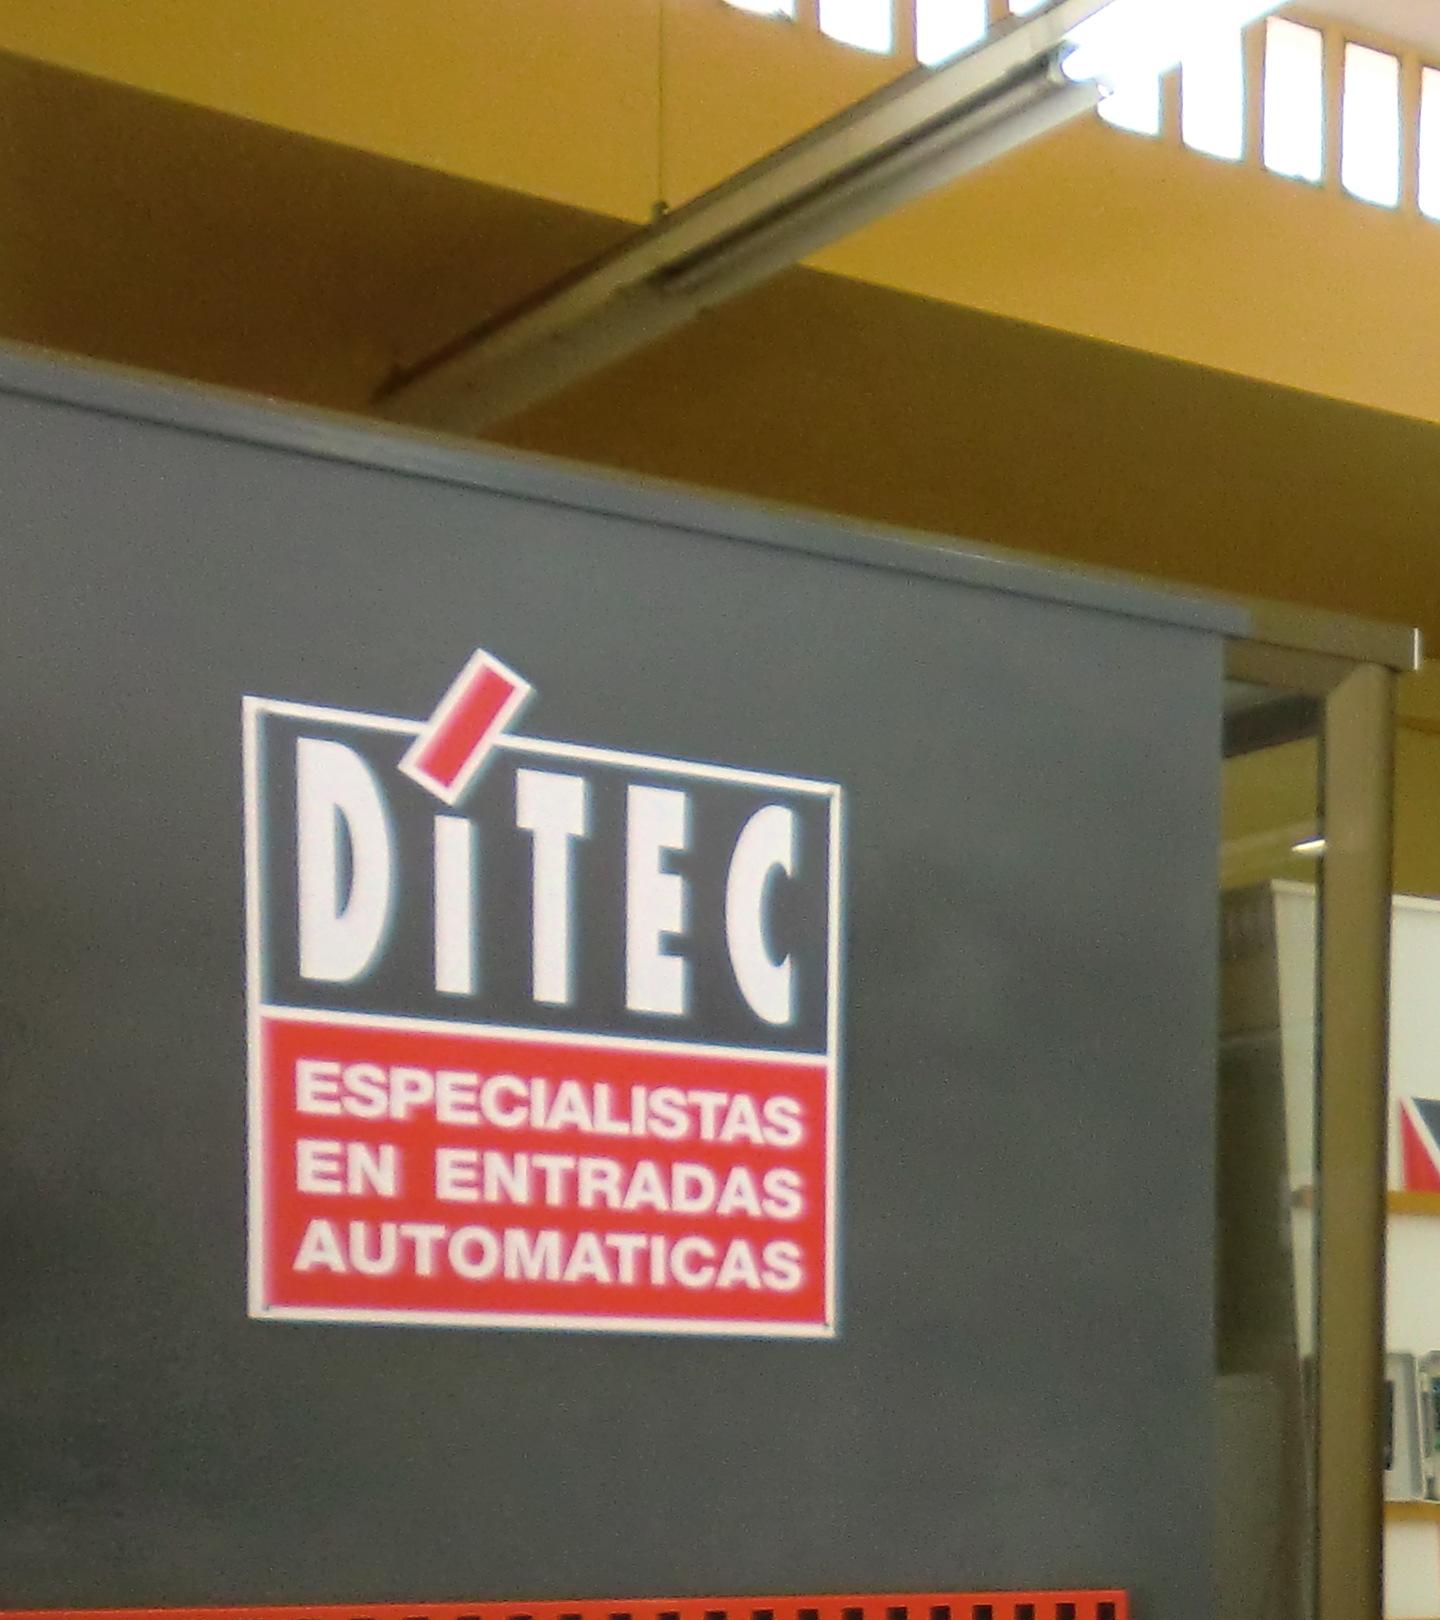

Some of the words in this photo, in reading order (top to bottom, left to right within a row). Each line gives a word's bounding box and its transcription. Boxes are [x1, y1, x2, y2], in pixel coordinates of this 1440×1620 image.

[296, 1058, 804, 1147] ESPECIALISTAS
[296, 1140, 400, 1198] EN
[434, 1146, 804, 1220] ENTRADAS
[293, 1219, 804, 1292] AUTOMATICAS
